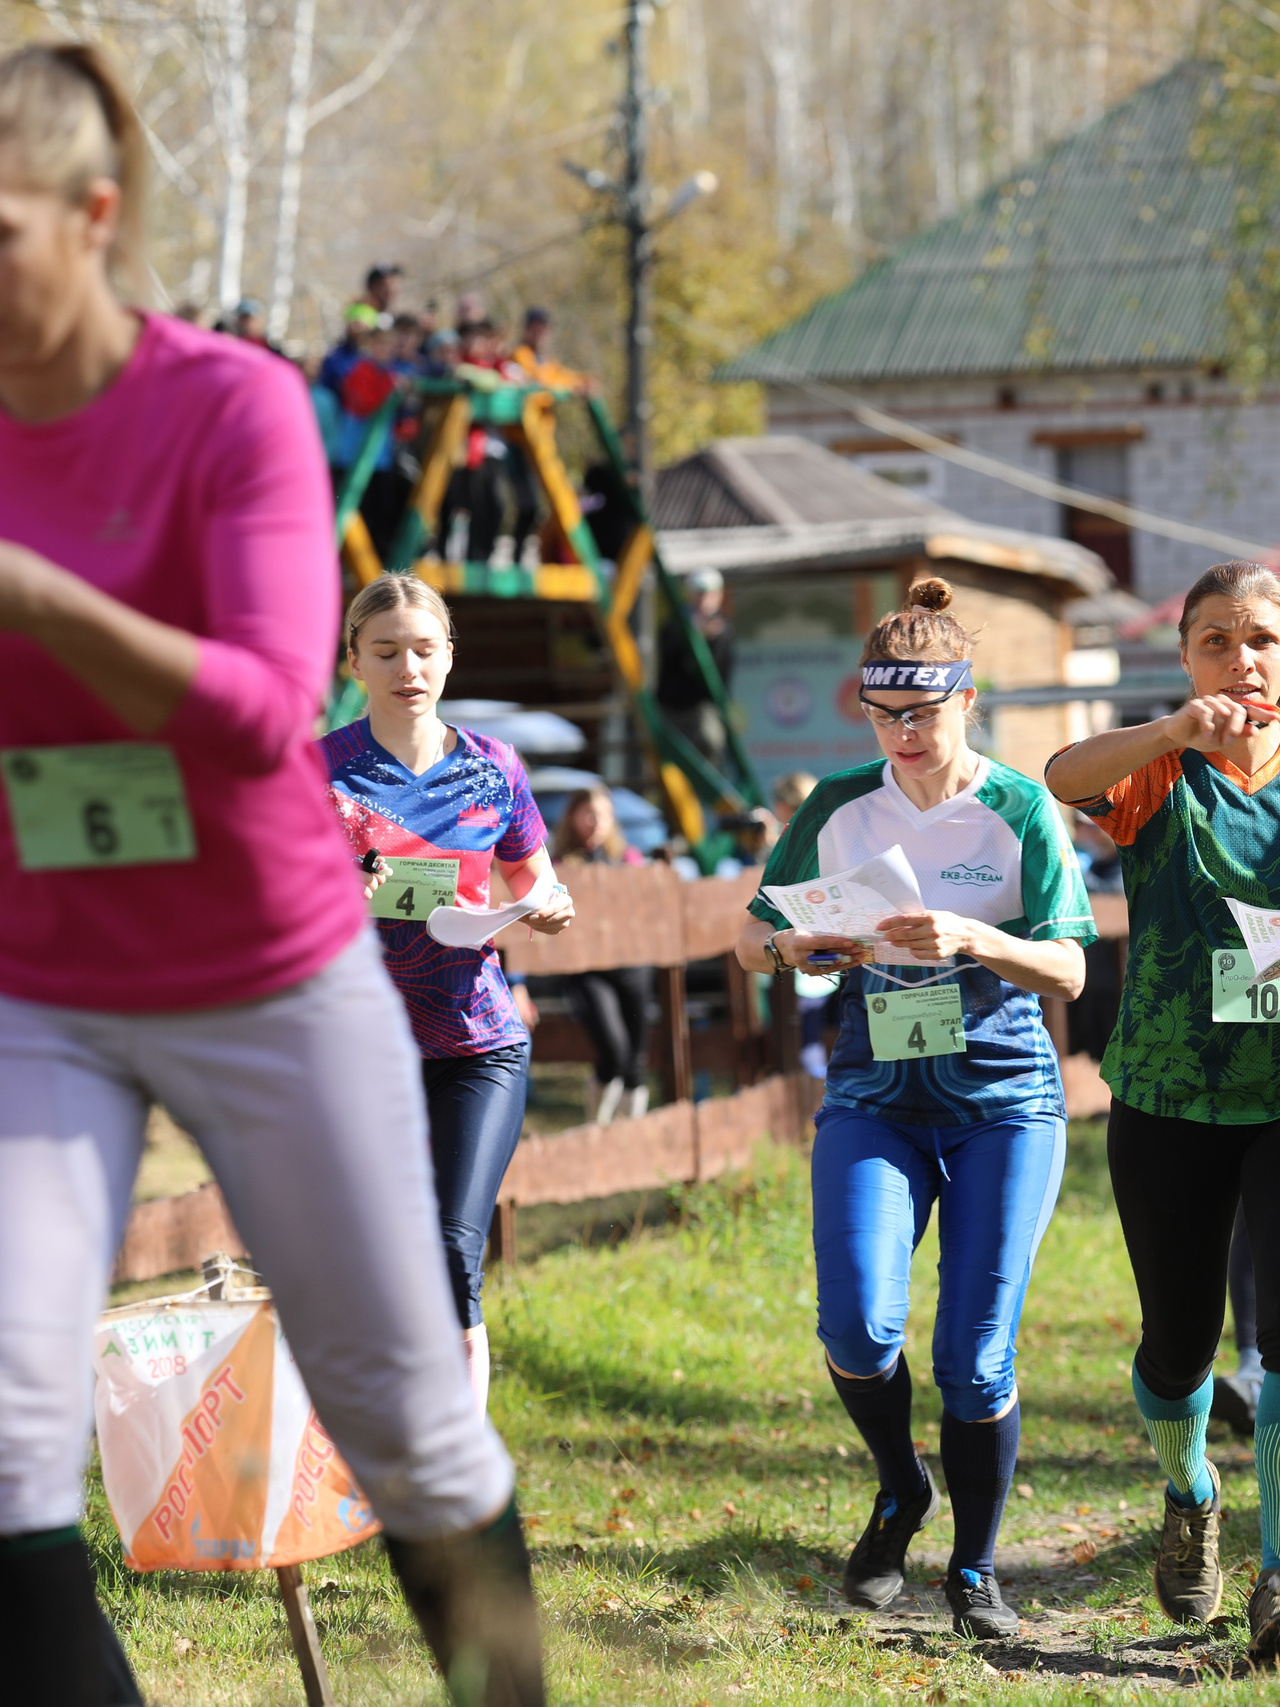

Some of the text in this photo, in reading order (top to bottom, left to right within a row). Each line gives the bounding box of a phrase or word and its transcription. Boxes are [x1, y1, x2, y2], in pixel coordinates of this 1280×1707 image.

[83, 799, 118, 855] 6
[941, 871, 1004, 882] EKB-O-TEAM
[396, 886, 415, 916] 4
[1245, 984, 1279, 1020] 10
[940, 1017, 961, 1026] ЭТАП
[907, 1021, 927, 1054] 4
